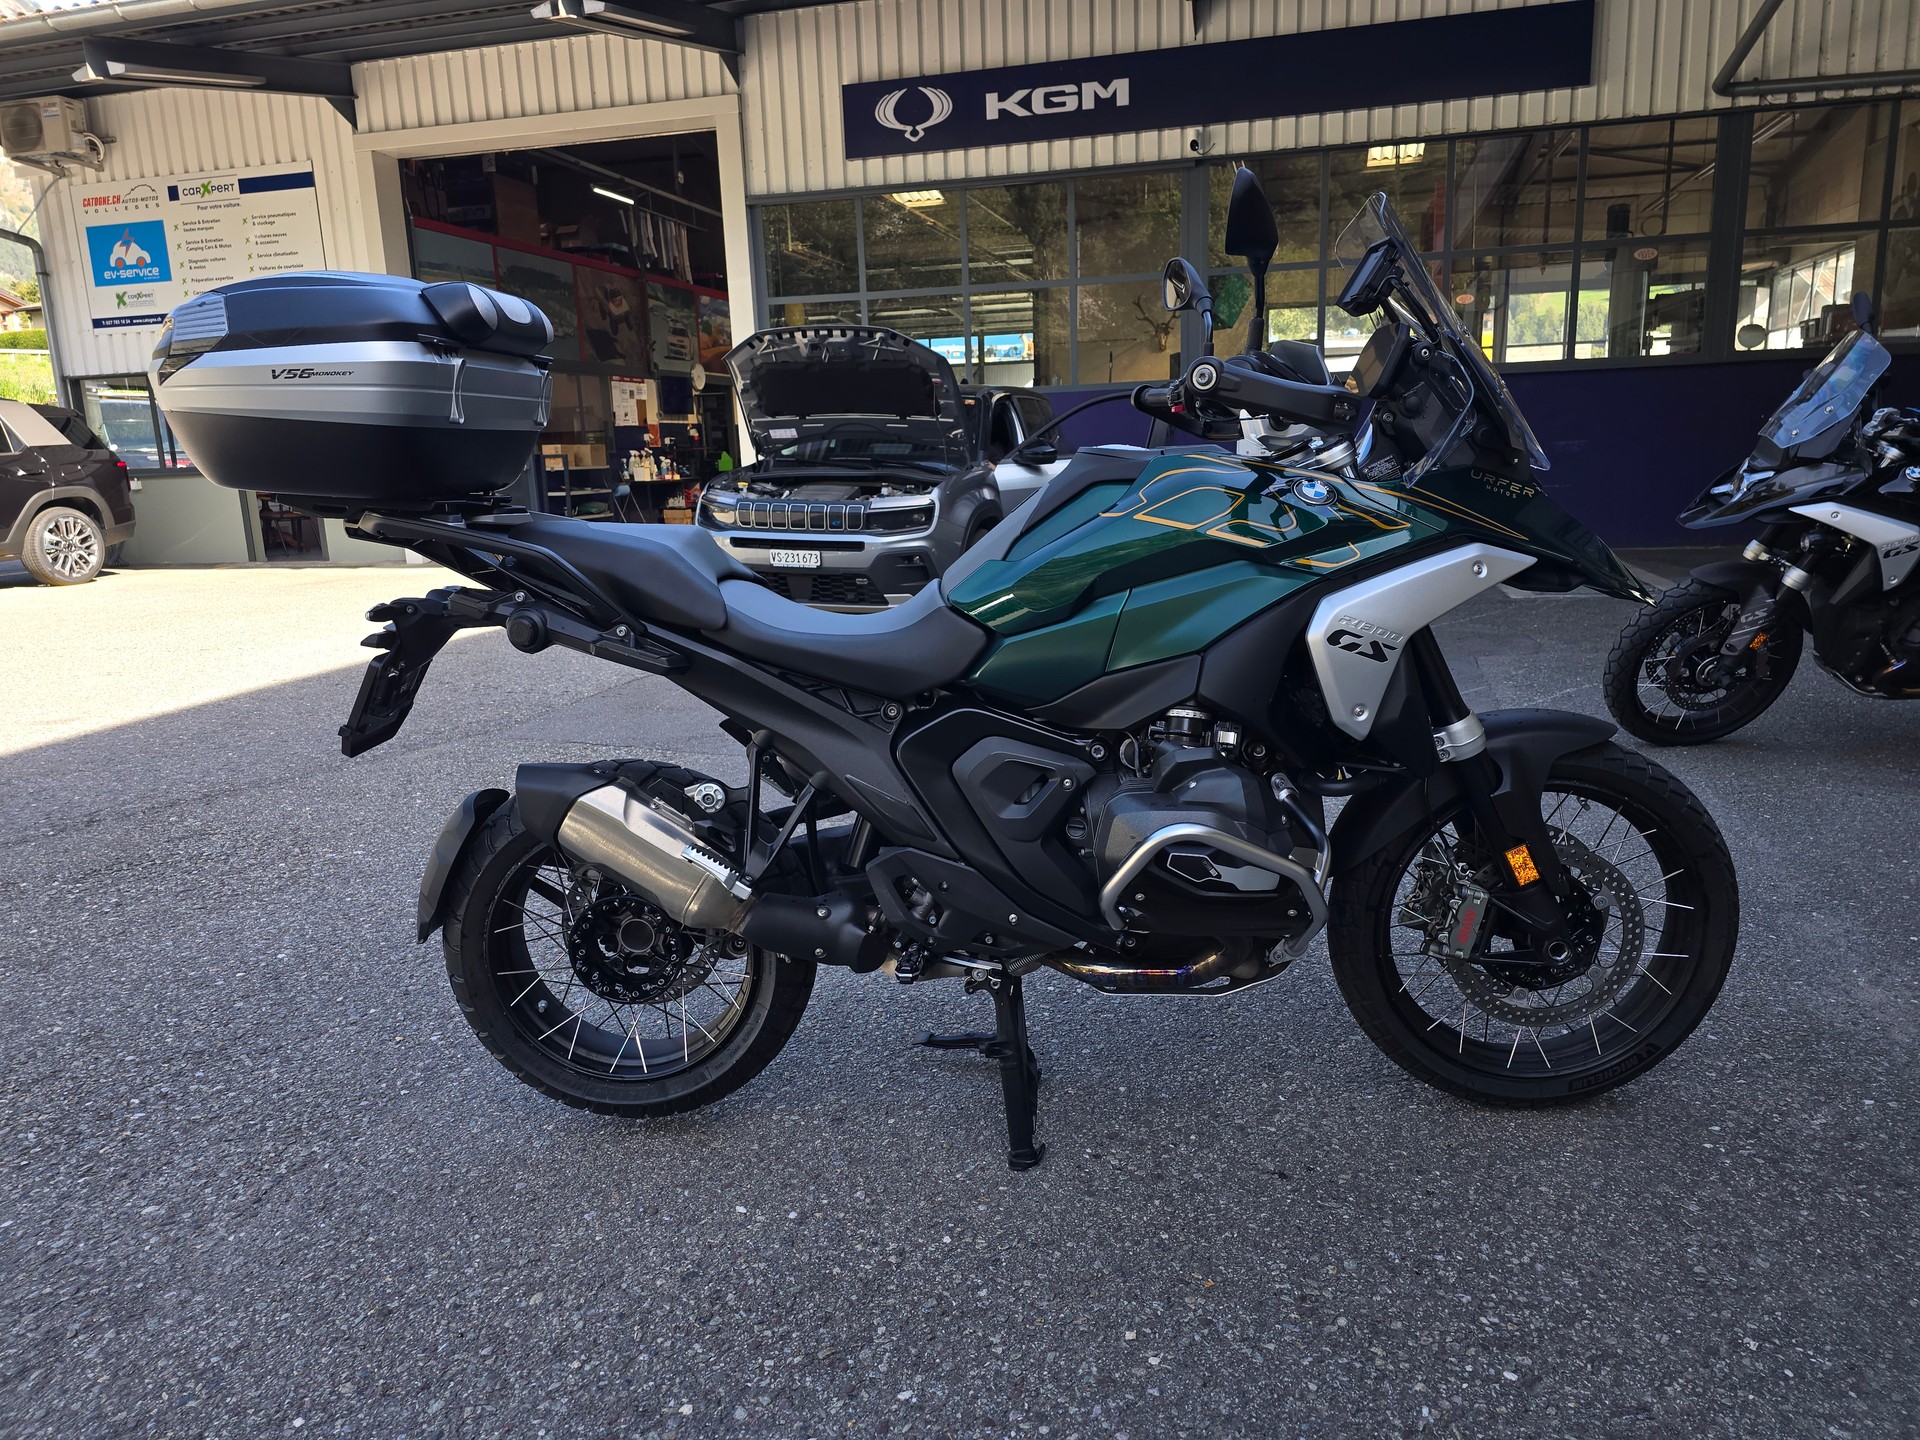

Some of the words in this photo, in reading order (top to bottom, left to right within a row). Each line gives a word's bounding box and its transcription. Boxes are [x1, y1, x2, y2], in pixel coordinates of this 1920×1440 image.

[986, 78, 1130, 120] KGM
[82, 194, 121, 208] CATOGNE.CH
[122, 195, 158, 204] AUTOS-MOTOS
[104, 267, 160, 279] ev-service
[271, 368, 314, 380] V56
[1471, 470, 1535, 498] URFER
[1486, 485, 1516, 498] MOTOS
[1882, 540, 1919, 559] GS
[1326, 629, 1399, 662] GS
[1572, 1056, 1638, 1090] MICHELIN
